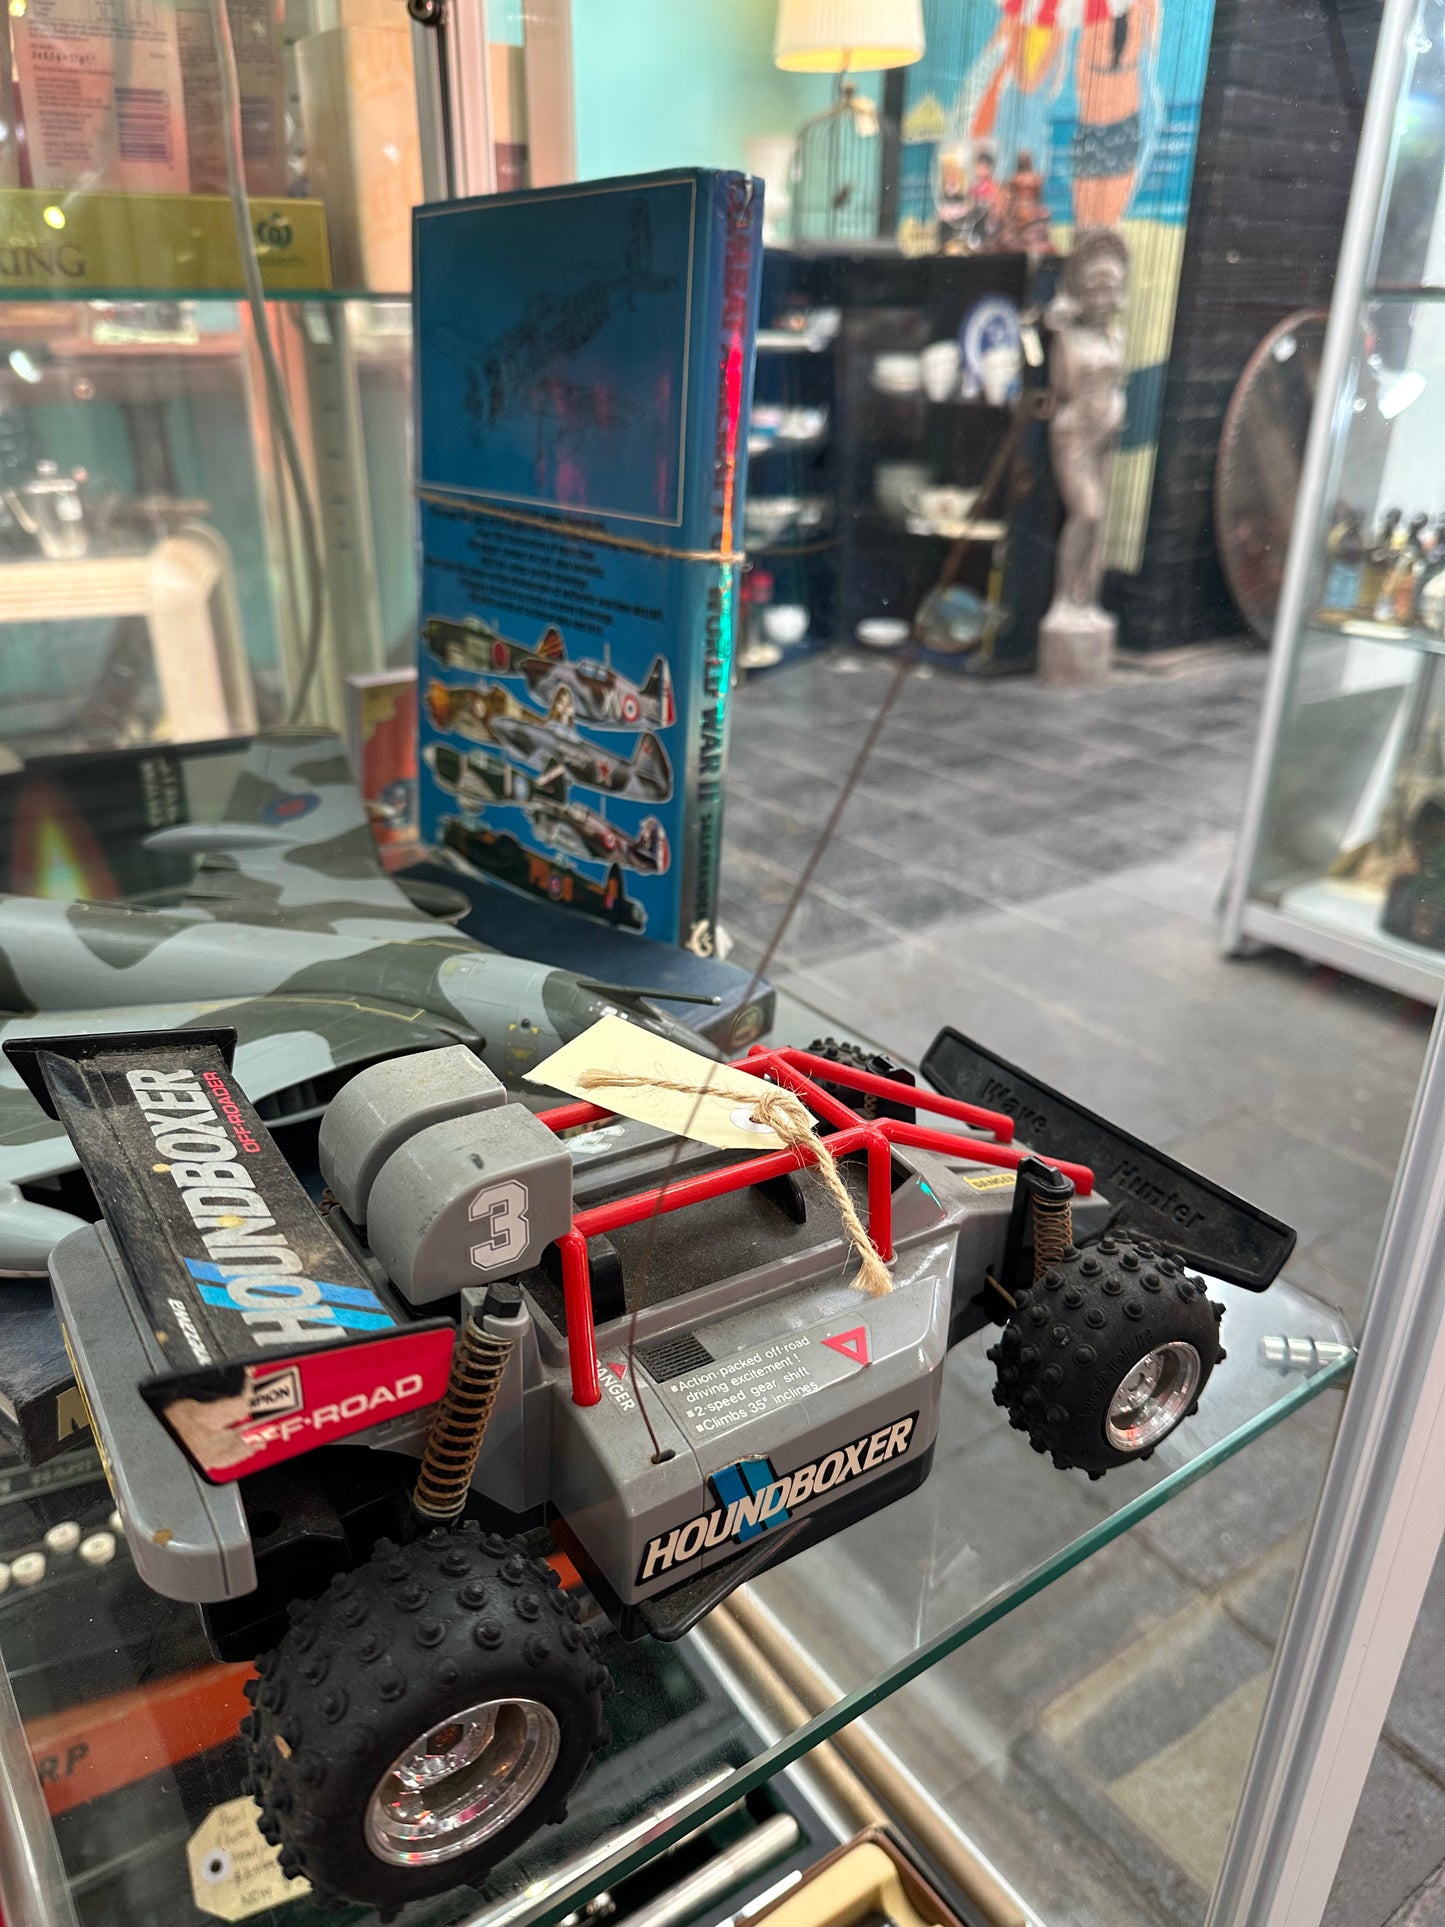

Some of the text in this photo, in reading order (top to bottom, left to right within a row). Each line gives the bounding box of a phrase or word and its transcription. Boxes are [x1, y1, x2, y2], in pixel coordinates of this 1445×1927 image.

[699, 707, 723, 776] WAR
[980, 1077, 1048, 1134] Wave
[126, 1069, 347, 1347] HOUNDBOXER
[468, 1179, 530, 1271] 3
[1107, 1160, 1206, 1228] Hunter
[686, 1381, 729, 1403] driving
[731, 1357, 793, 1387] excitement
[702, 1409, 748, 1432] Climbs
[772, 1380, 818, 1405] inclines
[750, 1380, 777, 1397] gear
[783, 1366, 810, 1383] shift
[642, 1417, 913, 1580] HOUNDBOXER
